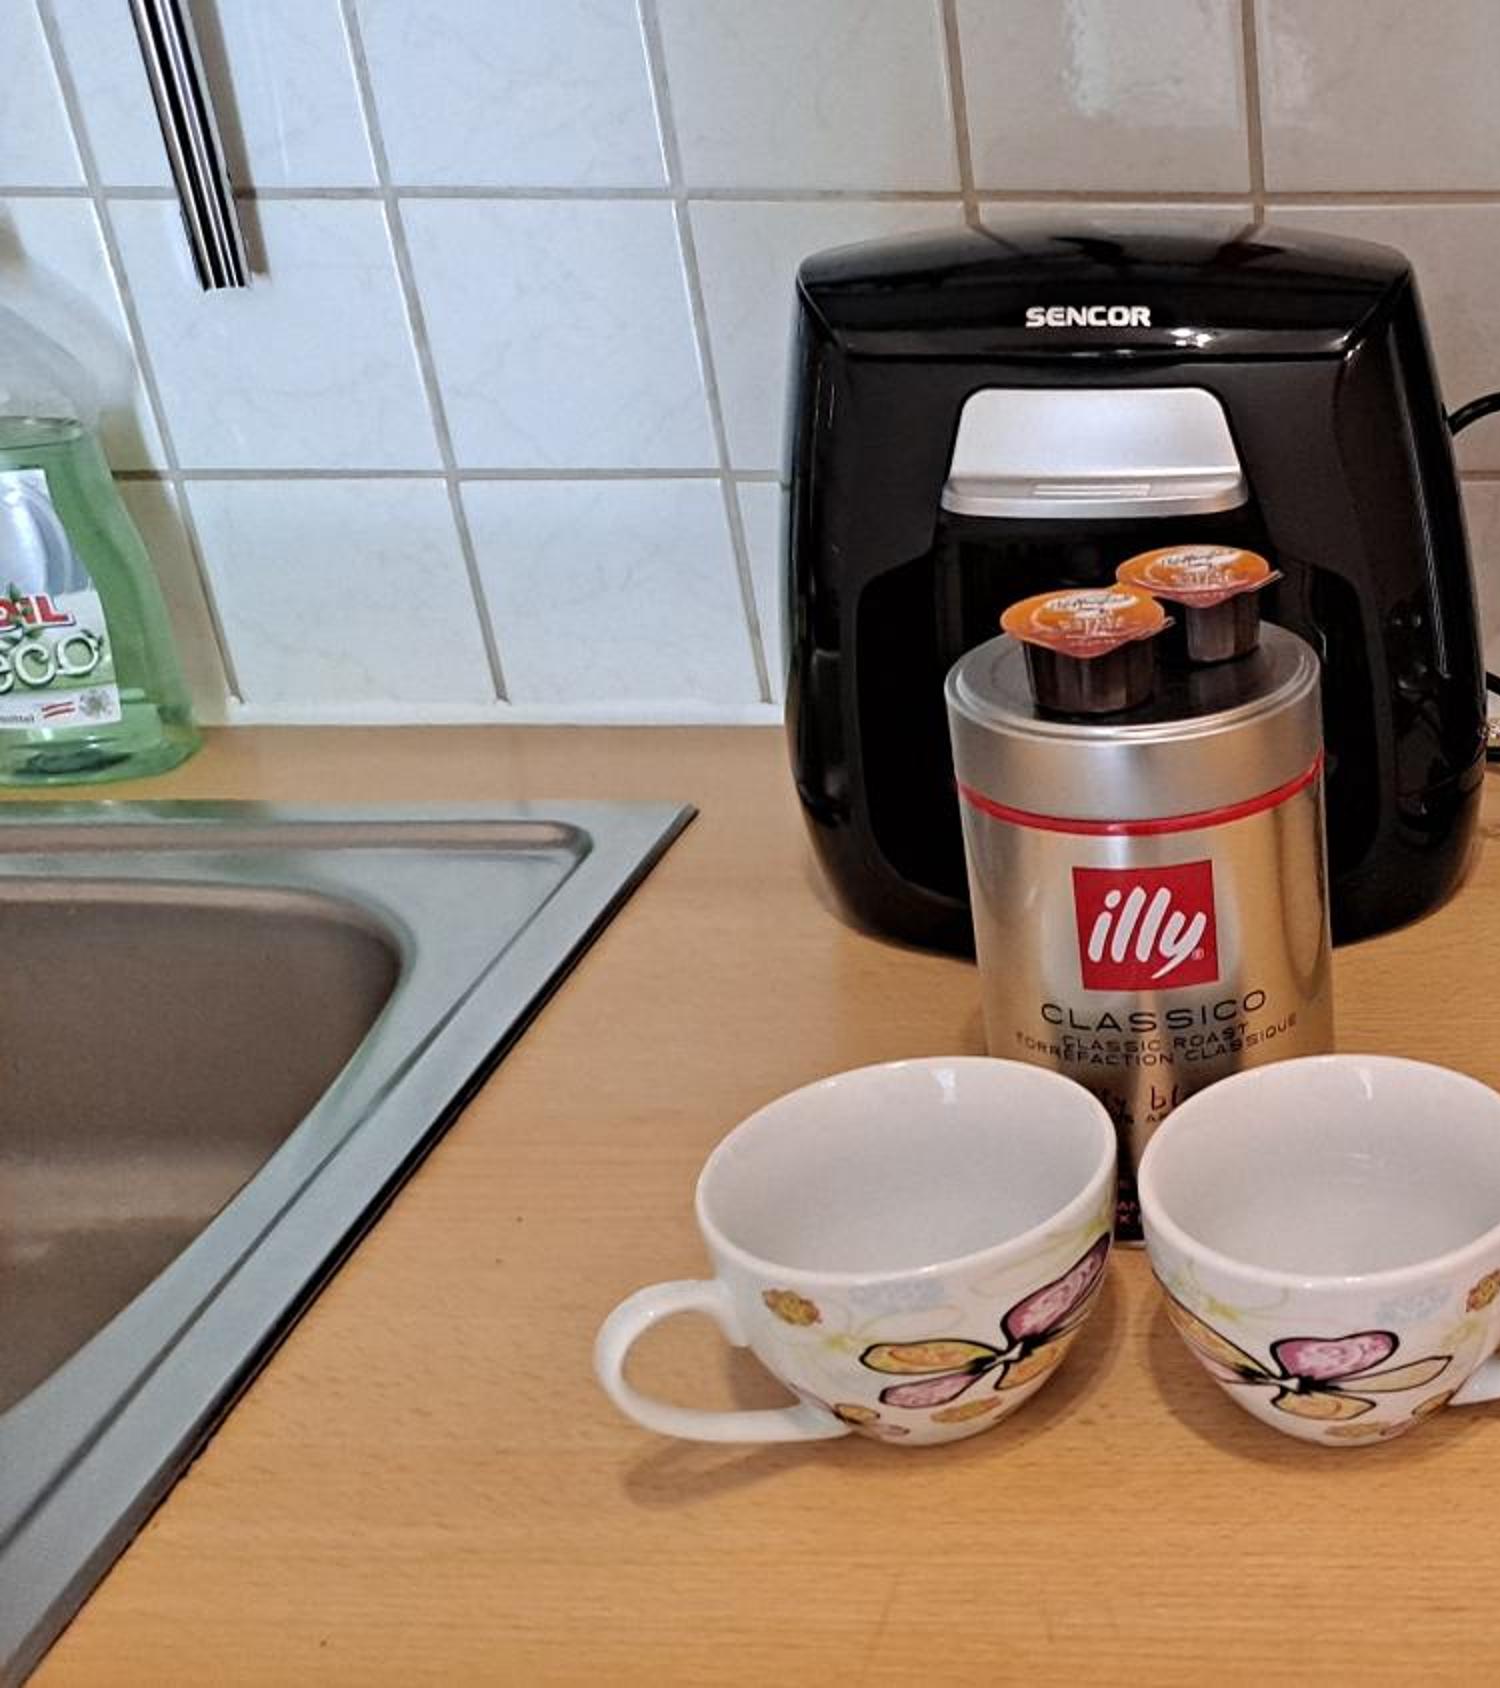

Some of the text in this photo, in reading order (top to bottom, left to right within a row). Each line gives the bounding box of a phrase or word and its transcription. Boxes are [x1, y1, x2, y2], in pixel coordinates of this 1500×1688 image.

[1025, 306, 1151, 327] SENCOR
[1087, 886, 1207, 979] illy
[1040, 989, 1266, 1033] CLASSICO
[1016, 1012, 1297, 1066] TORREFACTION CLASSIQUE
[1062, 1022, 1249, 1053] CLASSIC ROAST
